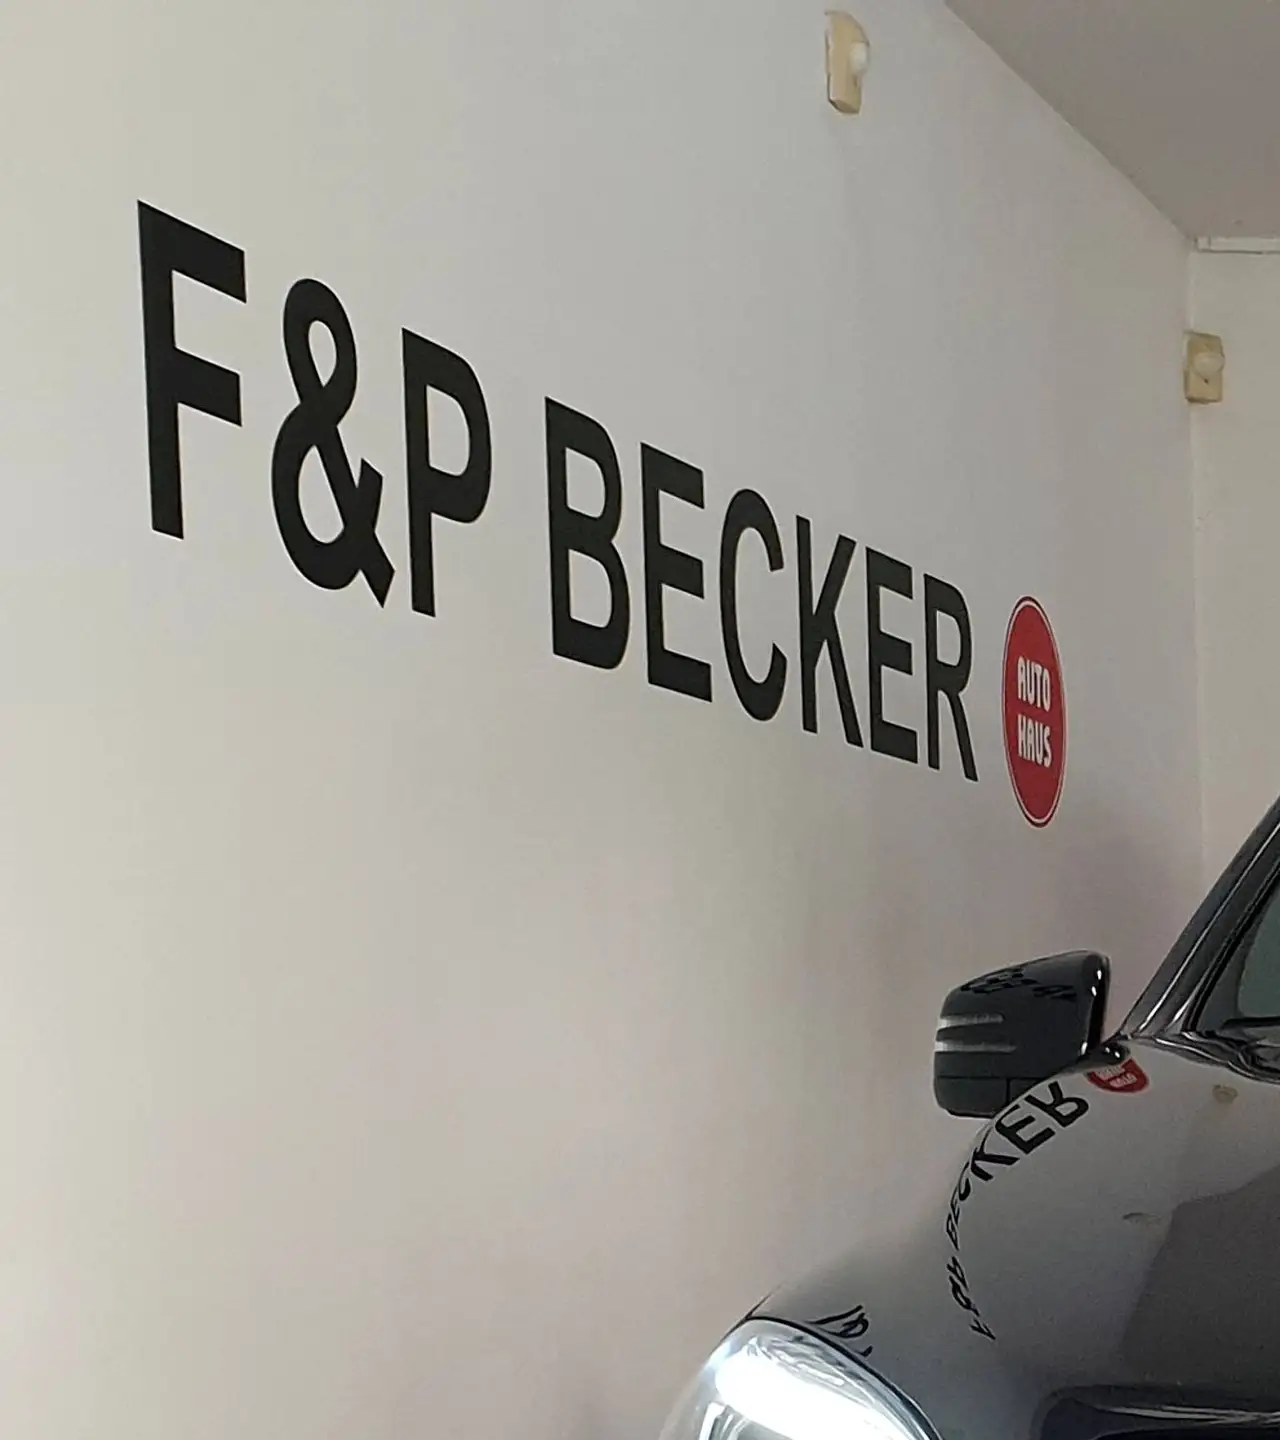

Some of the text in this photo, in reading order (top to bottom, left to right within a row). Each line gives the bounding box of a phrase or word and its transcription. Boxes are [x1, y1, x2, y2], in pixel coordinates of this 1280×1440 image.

[137, 200, 979, 783] F&P BECKER
[1017, 655, 1051, 712] AUTO
[1017, 713, 1053, 769] HAUS
